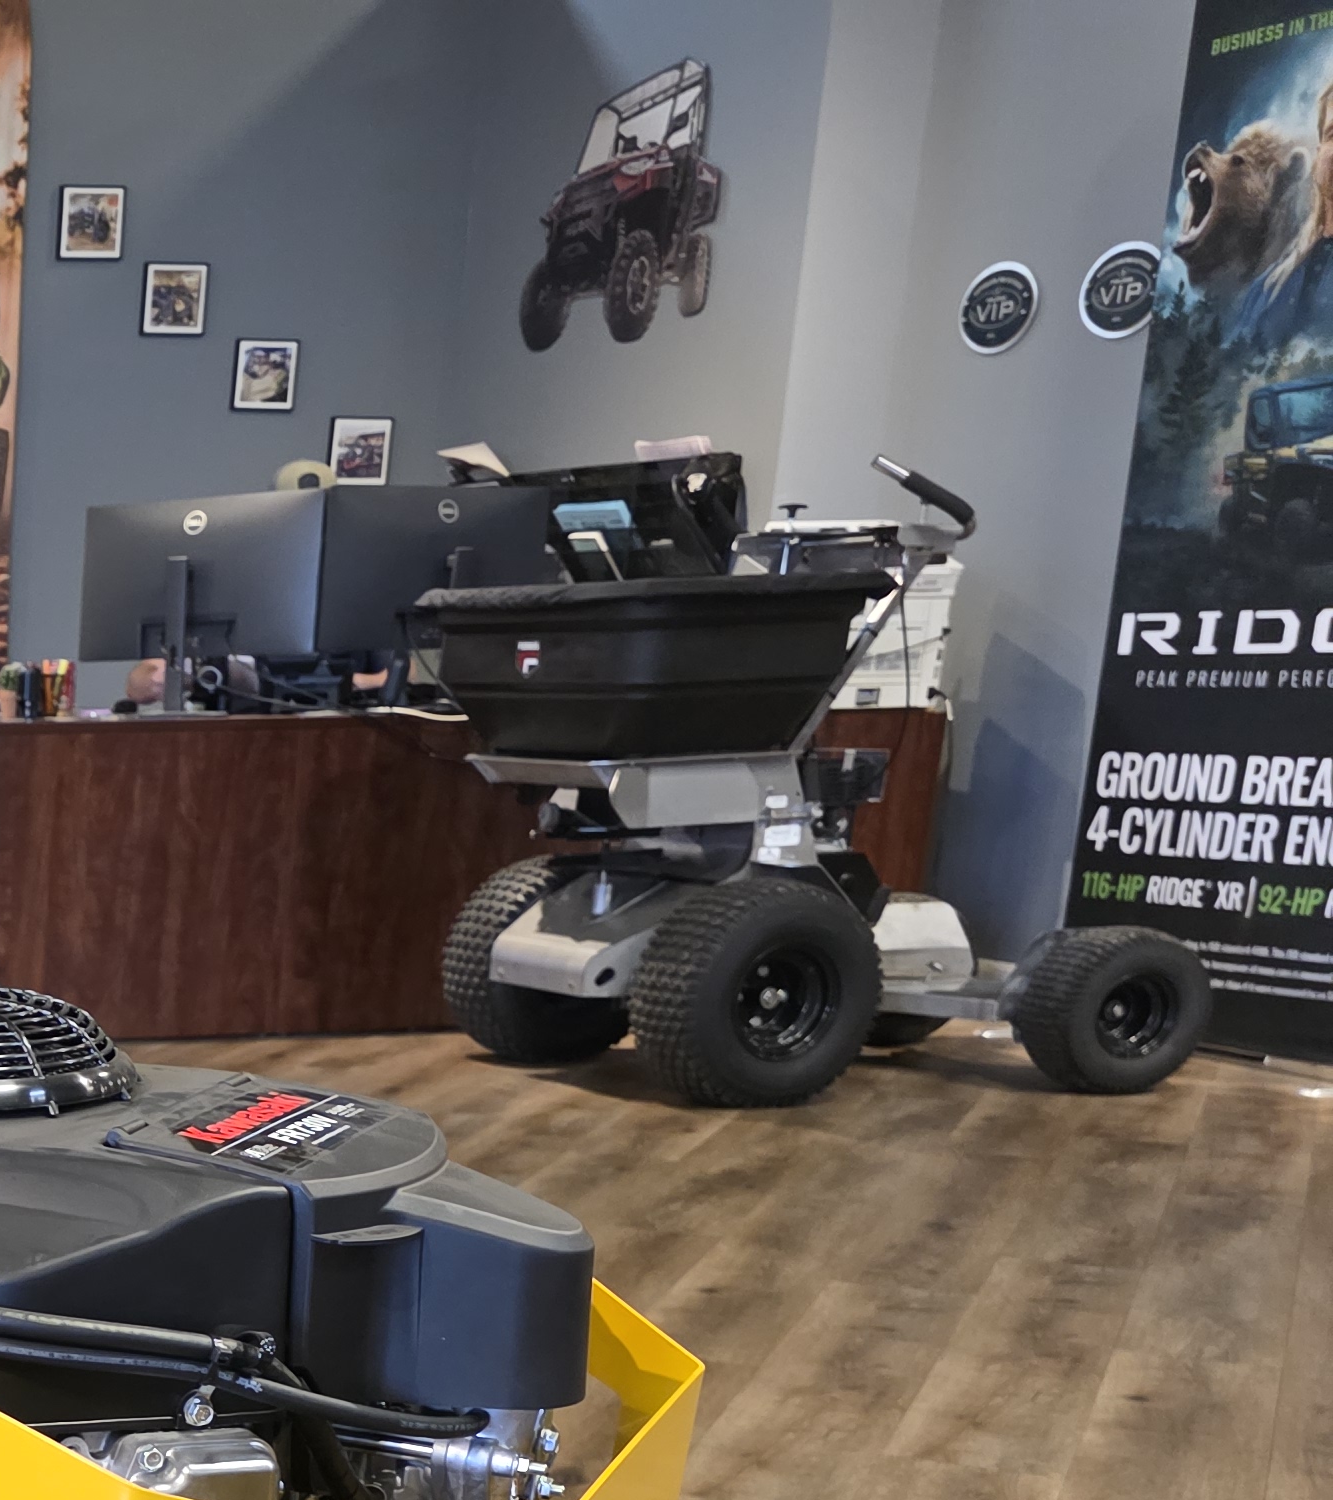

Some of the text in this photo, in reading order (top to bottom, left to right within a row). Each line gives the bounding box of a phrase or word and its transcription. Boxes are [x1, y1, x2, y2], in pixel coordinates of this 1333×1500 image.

[1211, 22, 1285, 56] BUSINESS
[1288, 18, 1305, 36] IN
[977, 300, 1014, 322] VIP
[1100, 282, 1142, 305] VIP
[1135, 669, 1179, 688] PEAK
[1186, 669, 1269, 688] PREMIUM
[1096, 751, 1237, 803] GROUND
[1086, 805, 1279, 864] 4-CYLINDER
[1082, 870, 1146, 902] 116-HP
[1214, 880, 1245, 912] XR
[1258, 884, 1325, 916] 92-HP
[177, 1091, 313, 1144] Kawasaki
[268, 1114, 338, 1145] FR730V
